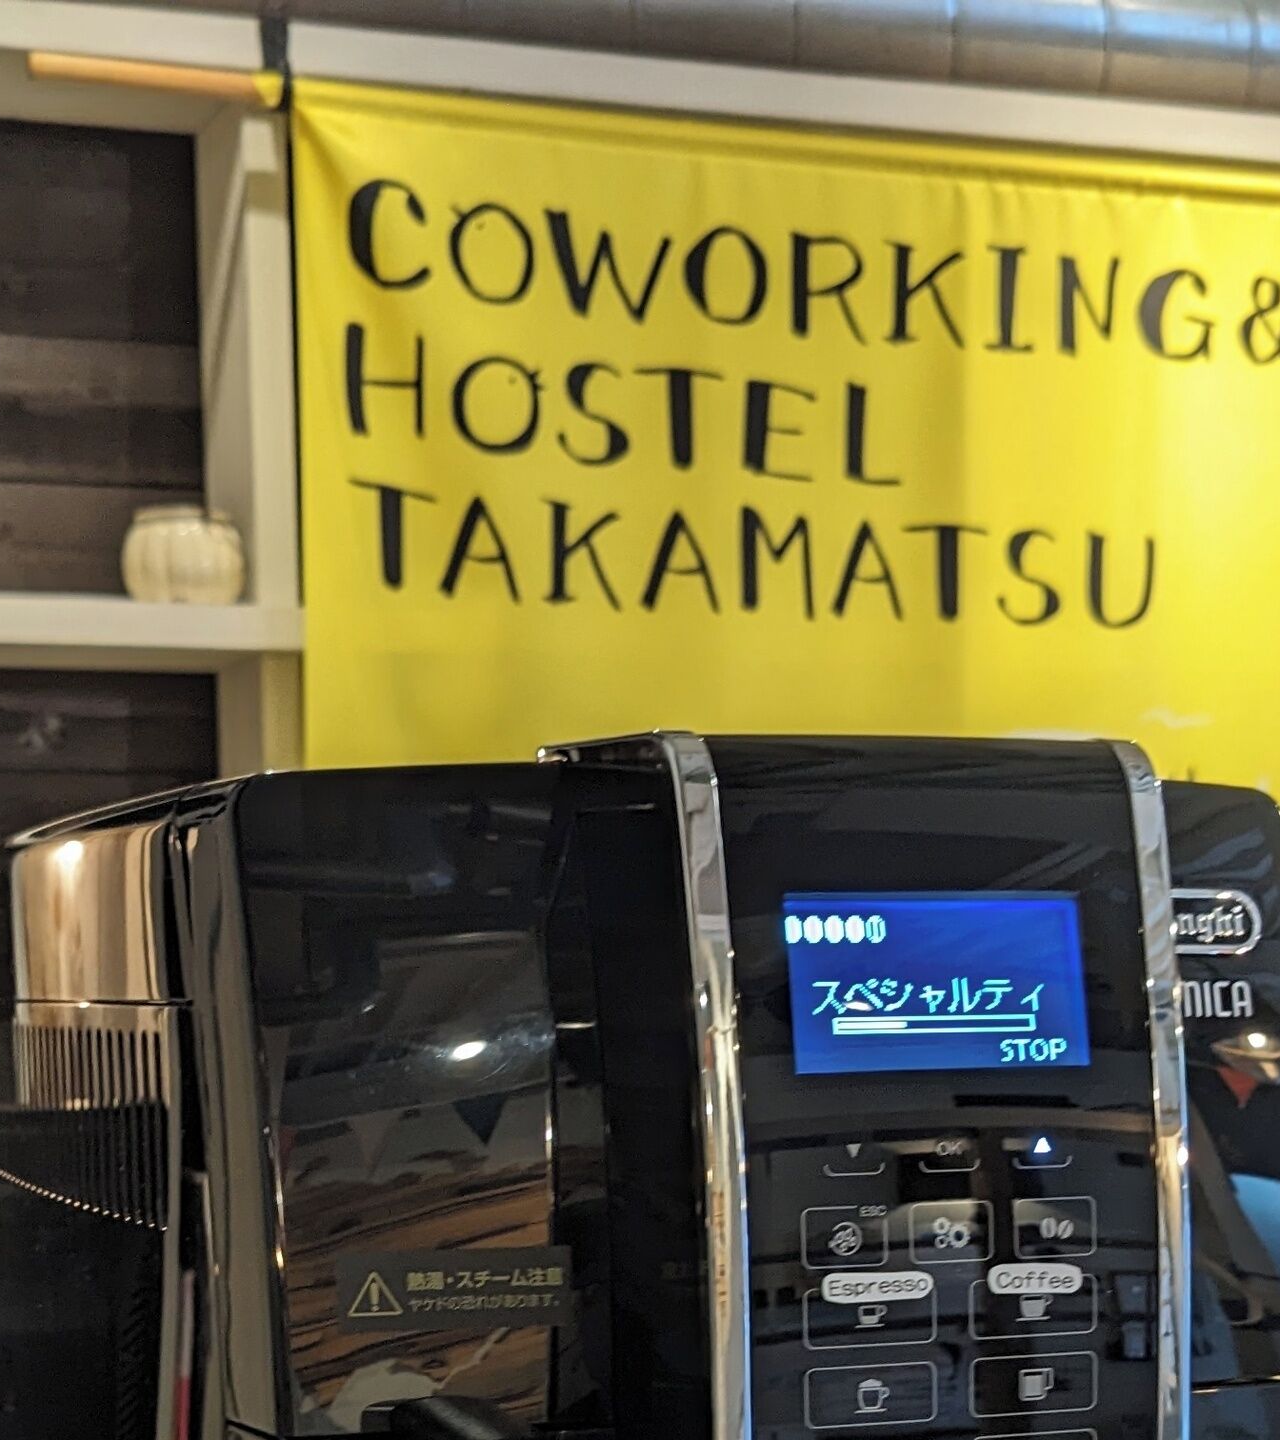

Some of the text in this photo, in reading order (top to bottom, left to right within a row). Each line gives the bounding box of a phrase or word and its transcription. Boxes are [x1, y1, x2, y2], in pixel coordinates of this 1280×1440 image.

[345, 323, 901, 487] HOSTEL
[349, 480, 1155, 631] TAKAMATSU
[811, 977, 1045, 1016] スペシャルティ
[999, 1037, 1068, 1063] STOP
[935, 1140, 964, 1156] OK
[827, 1277, 930, 1297] Espresso
[995, 1270, 1076, 1290] Coffee
